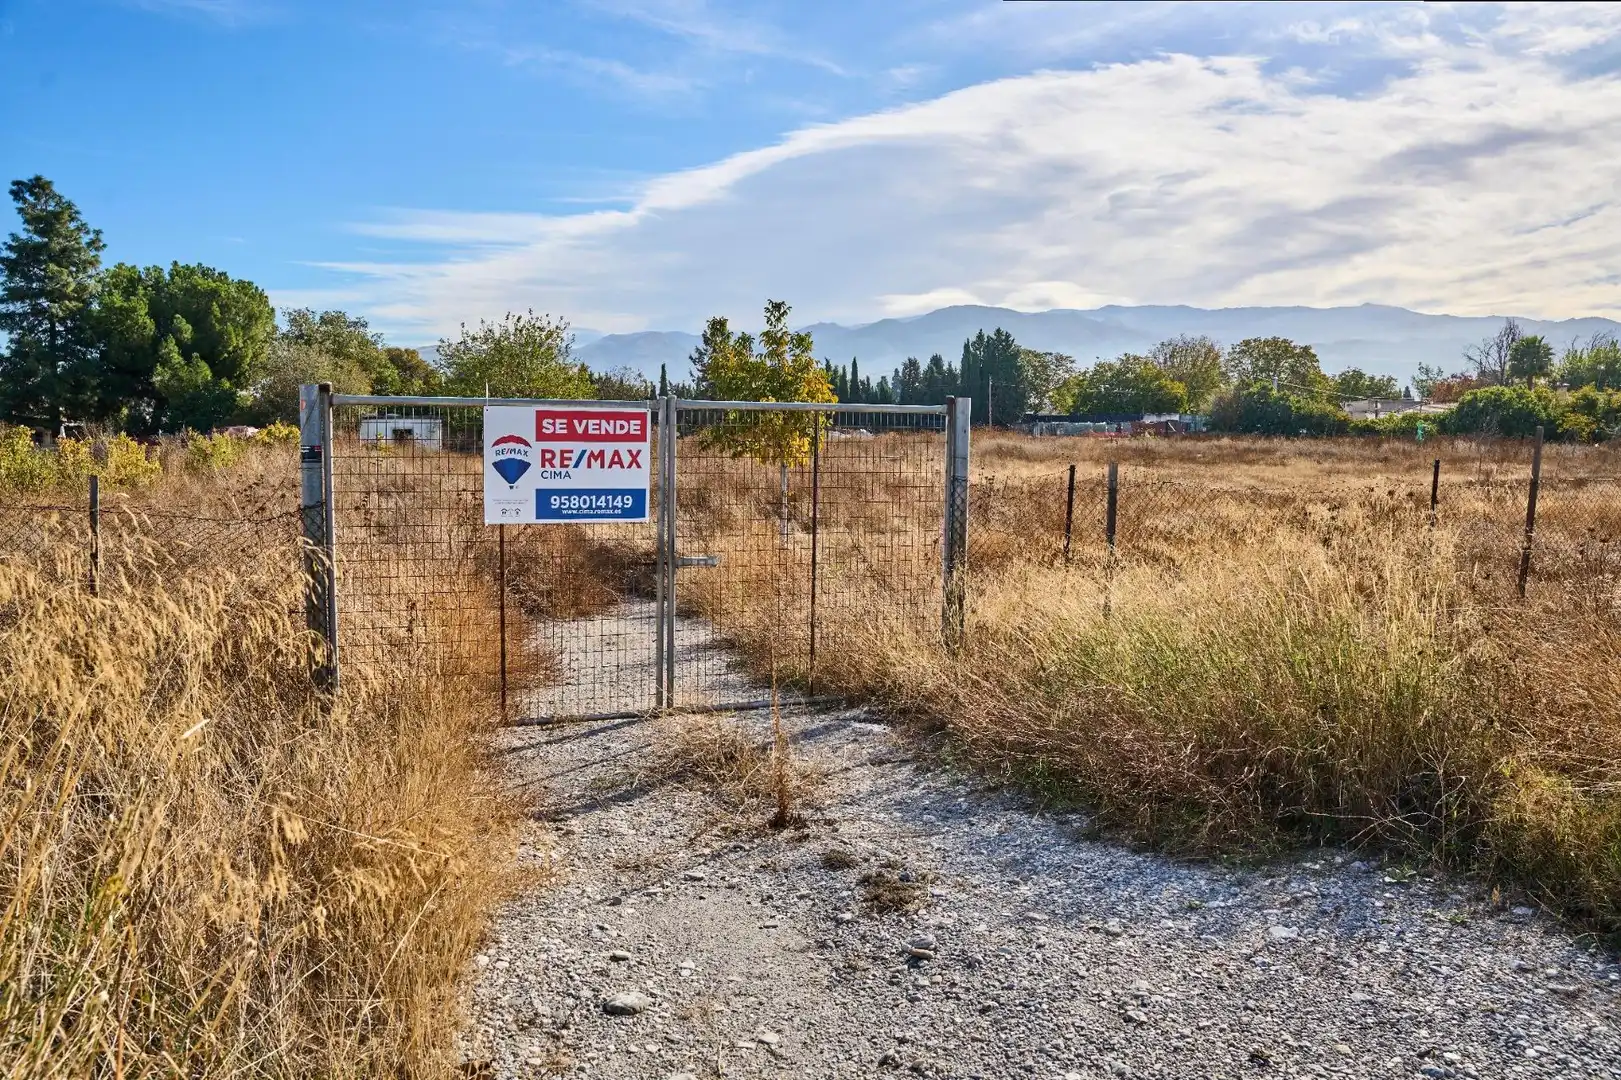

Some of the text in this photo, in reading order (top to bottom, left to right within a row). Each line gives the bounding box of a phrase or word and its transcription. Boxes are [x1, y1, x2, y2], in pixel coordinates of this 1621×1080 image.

[541, 418, 641, 435] SE VENDE
[495, 447, 529, 457] RE/MAX
[540, 448, 642, 469] RE/MAX
[540, 470, 572, 480] CIMA
[550, 495, 633, 509] 958014149
